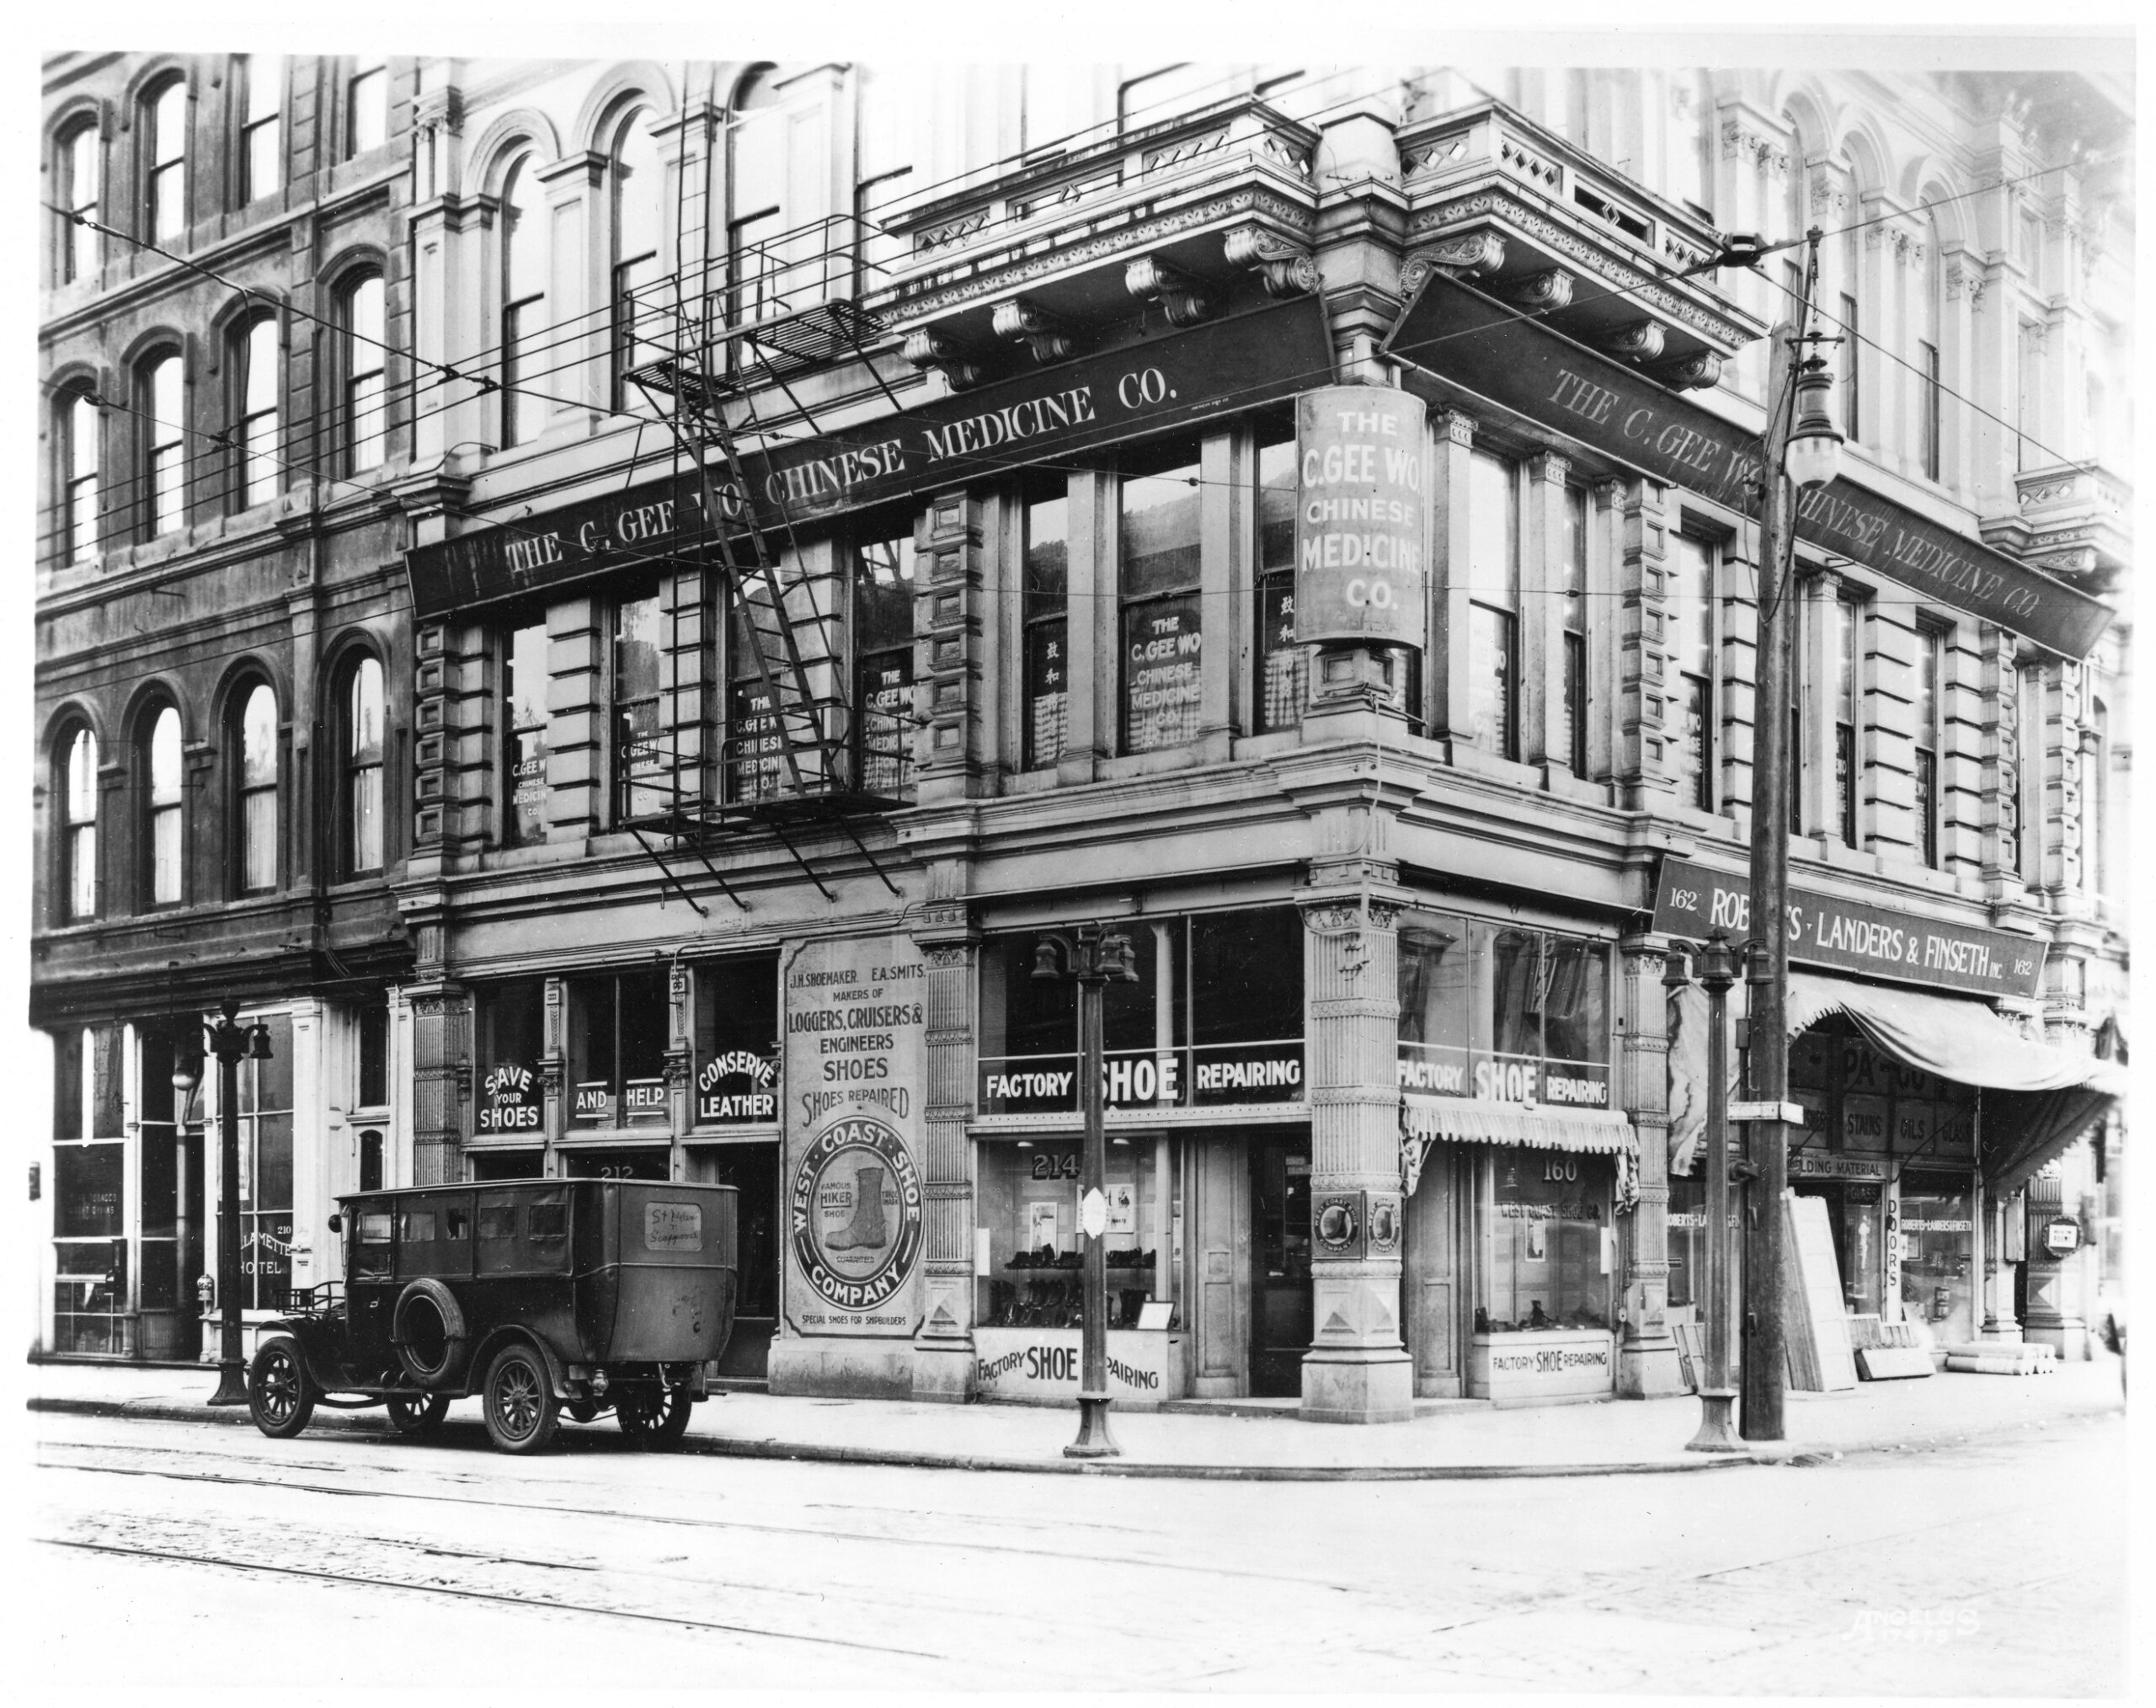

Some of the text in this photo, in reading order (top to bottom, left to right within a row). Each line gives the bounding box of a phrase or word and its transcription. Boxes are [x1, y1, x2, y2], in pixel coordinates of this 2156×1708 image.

[1337, 411, 1398, 435] THE
[505, 532, 563, 573] THE
[618, 499, 678, 543] GEE
[766, 439, 905, 505] CHINESE
[922, 386, 1096, 463] MEDICINE
[1118, 368, 1177, 408] CO.
[1546, 369, 1620, 425] THE
[1657, 424, 1721, 472] GEE
[1797, 489, 1889, 547] HINESE
[1886, 529, 2005, 600] MEDICINE
[1306, 499, 1414, 526] CHINESE
[1302, 533, 1420, 574] MEDICINE
[1347, 579, 1399, 610] CO.
[1152, 616, 1179, 635] THE
[1177, 632, 1202, 654] WO
[881, 670, 900, 686] THE
[1138, 662, 1193, 686] CHINESE
[1132, 685, 1201, 710] MEDICINE
[867, 732, 914, 751] MEDICNE
[513, 789, 547, 805] MEDICIN
[1669, 888, 1698, 911] 162
[1710, 888, 1802, 940] ROBS
[1816, 912, 1905, 962] LANDERS
[1906, 937, 1920, 965] &
[1924, 935, 1990, 976] FINSETH
[2013, 958, 2033, 975] 162
[833, 988, 883, 1002] MAKERS OF
[788, 1002, 923, 1033] LOGGERS, CRUISERS &
[820, 1033, 894, 1054] ENGINEERS
[485, 1066, 532, 1096] SAVE
[699, 1050, 775, 1092] CONSERVE
[823, 1057, 889, 1081] SHOES
[987, 1072, 1073, 1098] FACTORY
[1197, 1059, 1300, 1090] REPAIRING
[1397, 1059, 1607, 1103] FACTORY SHOE REPAIRING
[496, 1092, 522, 1104] YOUR
[576, 1087, 664, 1109] AND HELP
[701, 1094, 774, 1118] LEATHER
[802, 1087, 910, 1128] SHOES REPAIRED
[480, 1106, 538, 1128] SHOES
[1848, 1113, 1881, 1136] STAINS
[1900, 1118, 1925, 1140] OILS
[1032, 1154, 1080, 1180] 214
[1542, 1159, 1577, 1182] 160
[1837, 1162, 1881, 1177] MATERIAL
[793, 1123, 921, 1236] WEST COAST SHOE
[821, 1182, 851, 1191] FAMOUS
[821, 1192, 852, 1204] HIKER
[1325, 1198, 1347, 1206] COAST
[1501, 1204, 1524, 1218] WEST
[1529, 1204, 1556, 1220] COAST
[1561, 1204, 1583, 1220] SHOE
[277, 1226, 291, 1235] 210
[241, 1232, 292, 1257] LAMETTE
[1319, 1238, 1352, 1252] COMPANY
[1888, 1199, 1897, 1287] DOORS
[812, 1260, 901, 1305] COMPANY
[802, 1315, 906, 1326] SPECIAL SHOES FOR SHIPBUILDERS
[978, 1346, 1159, 1390] FACTORY SHOE PAIRING
[1492, 1350, 1607, 1372] FACTORY SHOE REPAIRING
